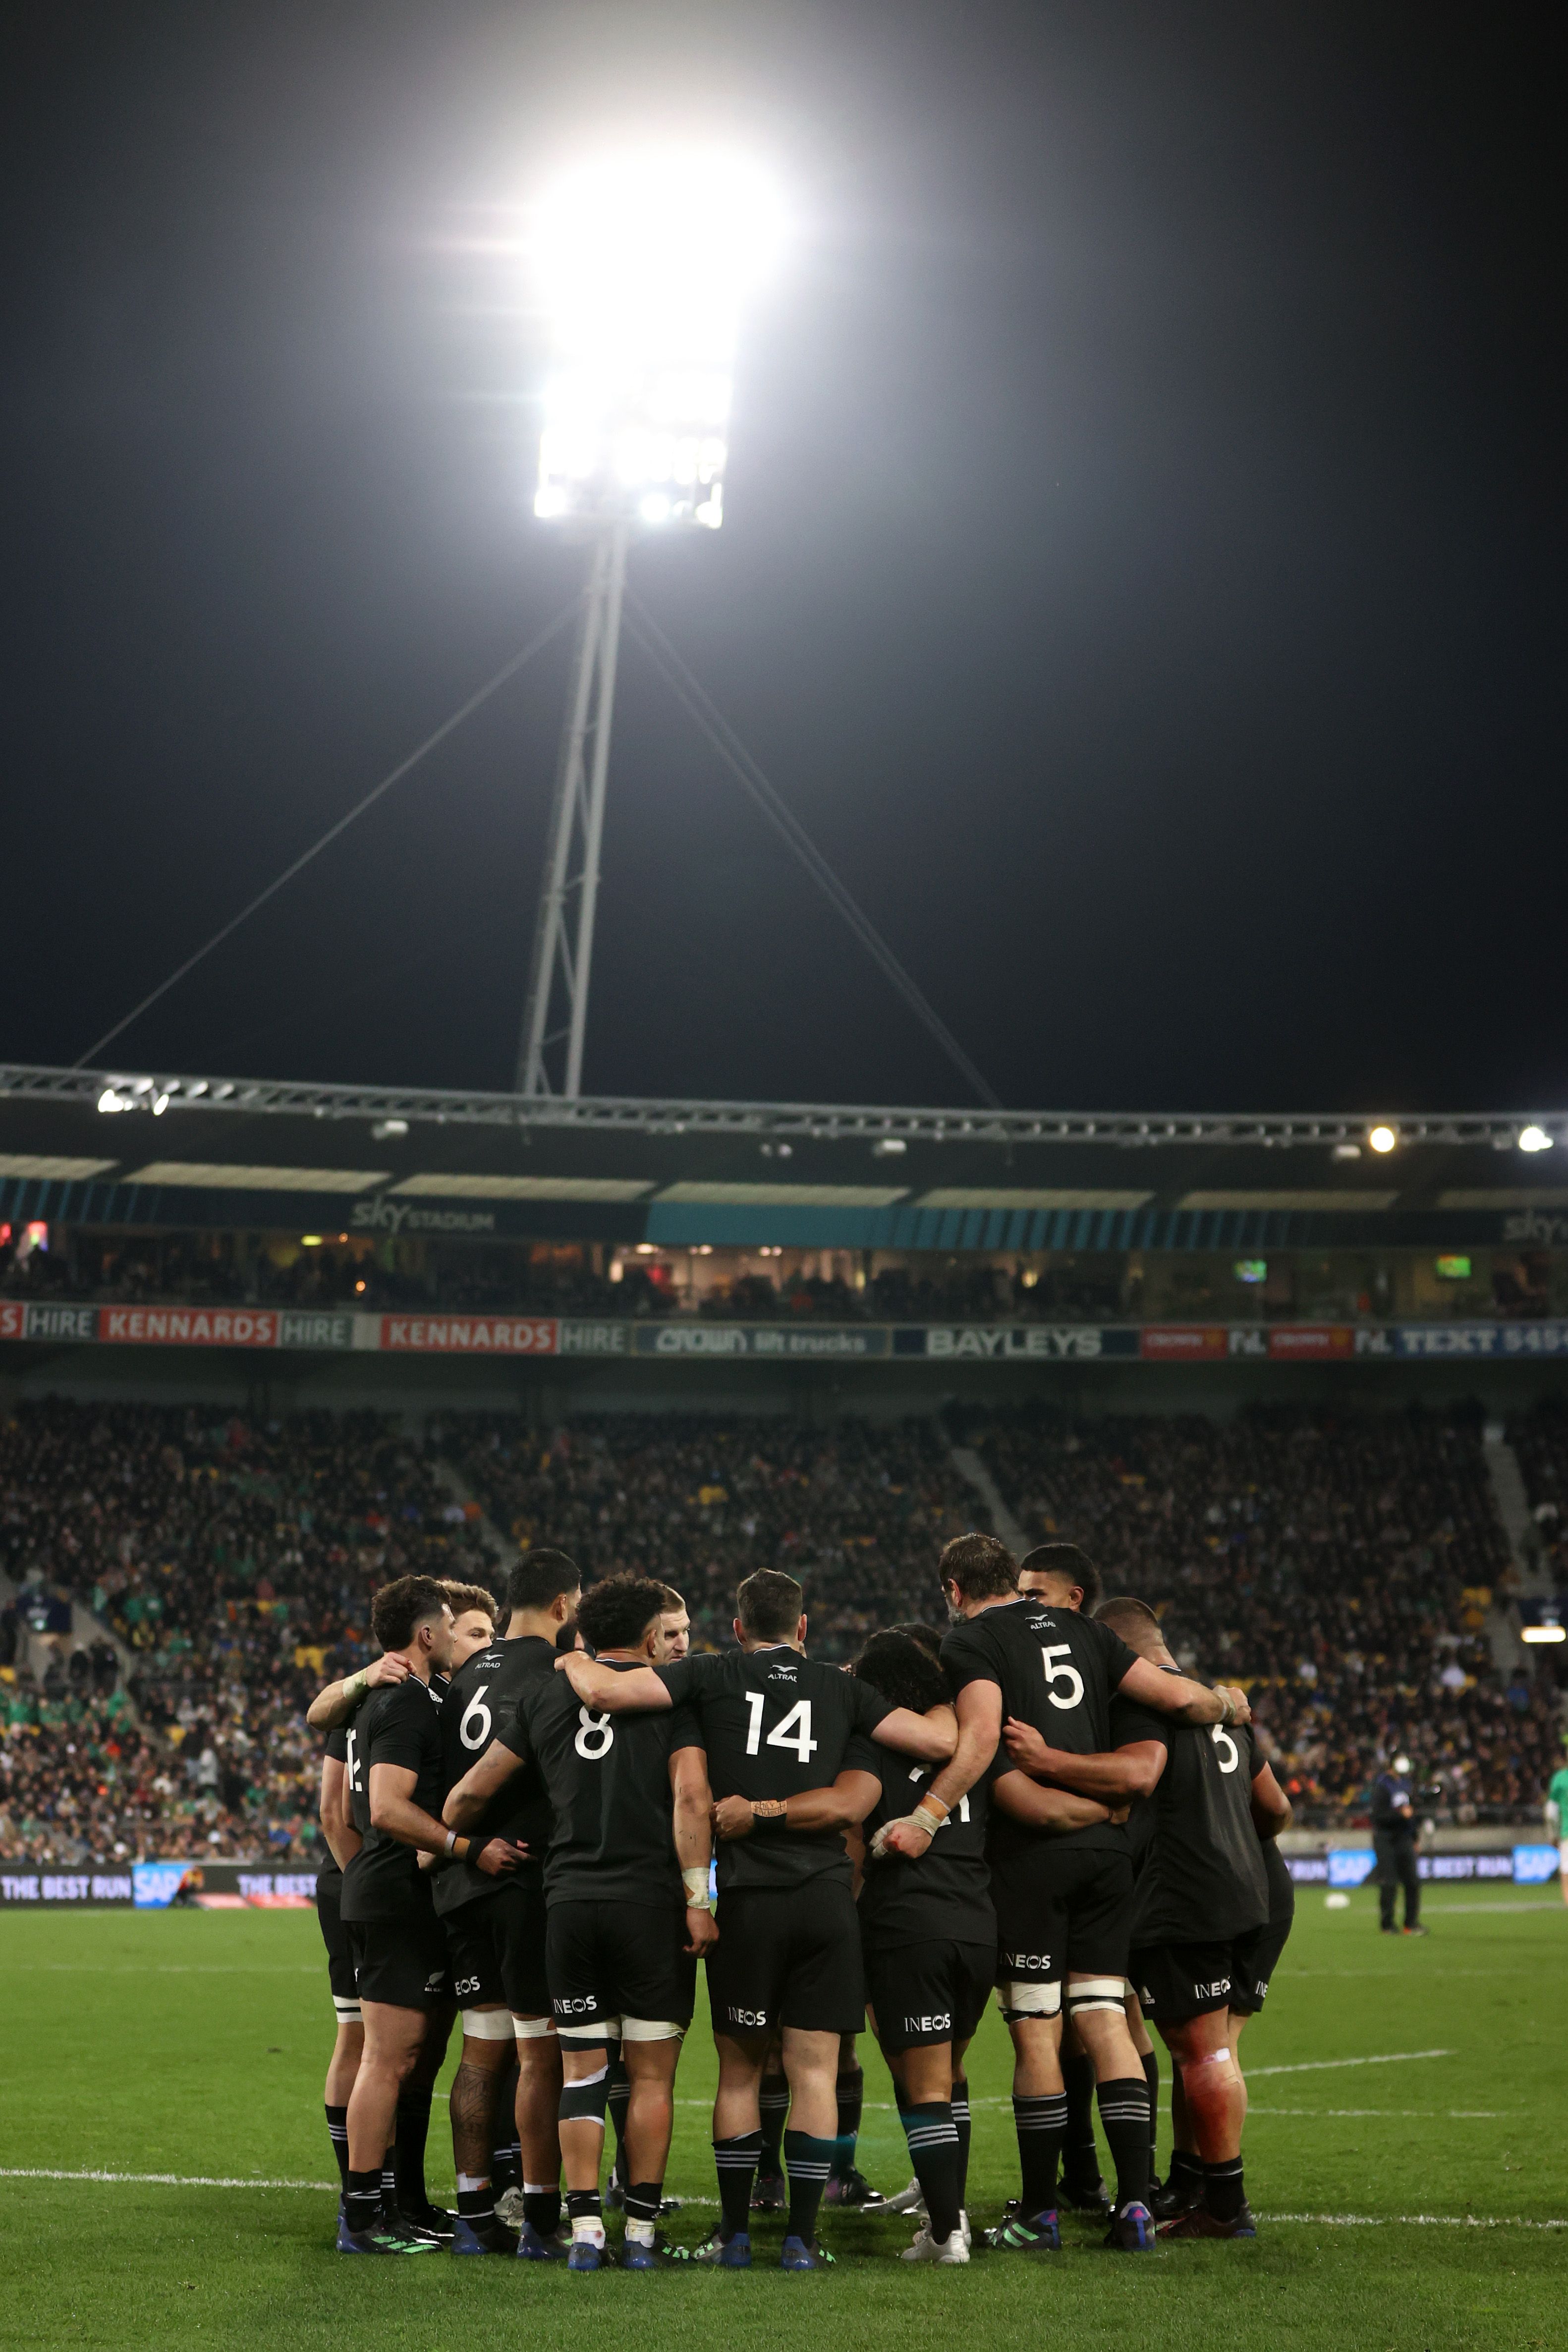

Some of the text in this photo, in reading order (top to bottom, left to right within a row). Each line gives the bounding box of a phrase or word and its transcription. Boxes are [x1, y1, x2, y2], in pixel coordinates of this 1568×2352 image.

[28, 1309, 93, 1337] HIRE
[109, 1312, 345, 1344] KENNARDS HIRE
[389, 1320, 625, 1352] KENNARDS HIRE
[926, 1328, 1103, 1357] BAYLEYS
[1402, 1329, 1498, 1352] TEXT
[1030, 1621, 1056, 1629] ALTRAD
[1041, 1644, 1085, 1710] 5
[460, 1685, 492, 1750] 6
[745, 1690, 818, 1764] 14
[575, 1705, 614, 1760] 8
[2, 1871, 179, 1902] THE BEST RUN SAP
[455, 1976, 480, 1996] EOS
[554, 1995, 597, 2014] INEOS
[728, 2006, 766, 2026] INEOS
[904, 2013, 951, 2032] INEOS
